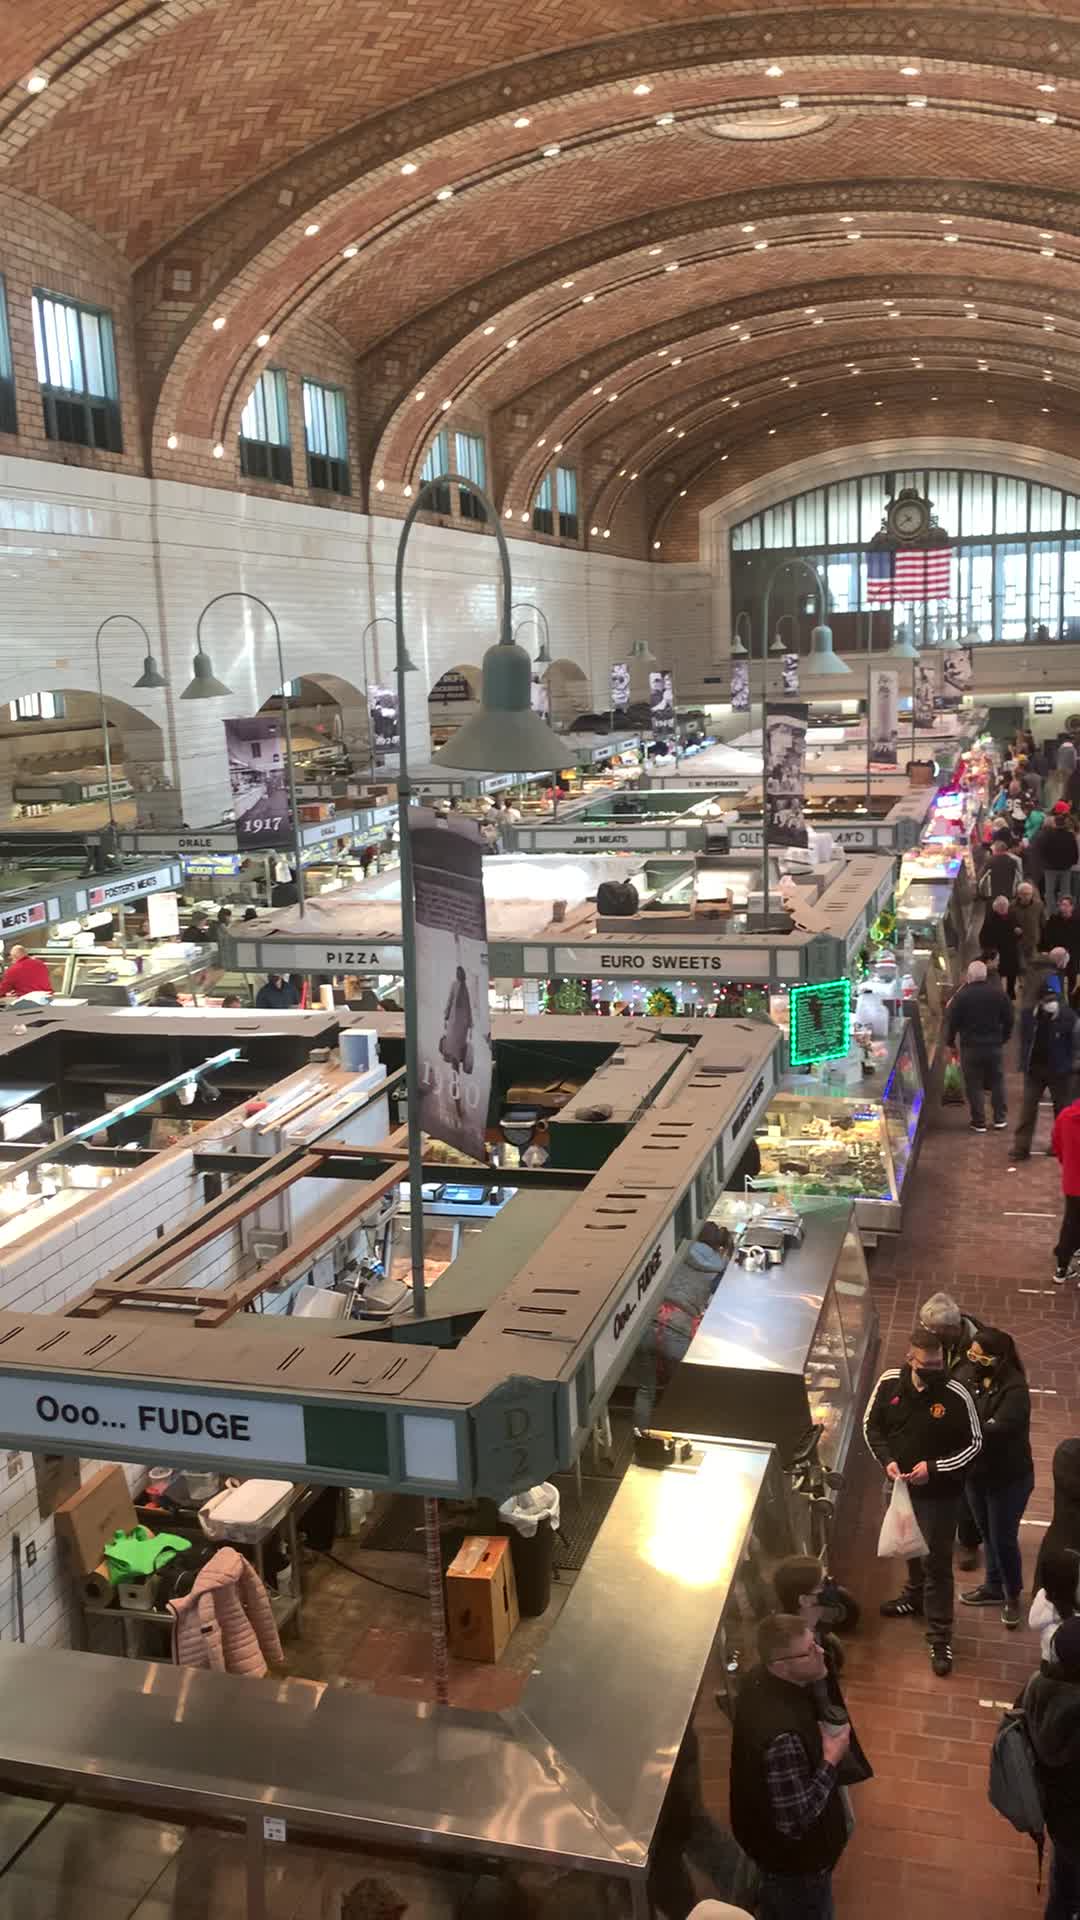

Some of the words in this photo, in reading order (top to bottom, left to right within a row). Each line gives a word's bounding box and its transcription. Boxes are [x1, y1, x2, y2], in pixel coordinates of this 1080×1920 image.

[243, 817, 283, 833] 1917
[178, 839, 212, 848] ORALE
[573, 835, 595, 844] JIM'S
[598, 835, 629, 844] MEATS
[738, 832, 764, 844] OLI
[326, 952, 380, 964] PIZZA
[600, 955, 645, 969] EURO
[652, 956, 722, 970] SWEETS
[36, 1395, 126, 1430] Ooo...
[138, 1405, 251, 1442] FUDGE
